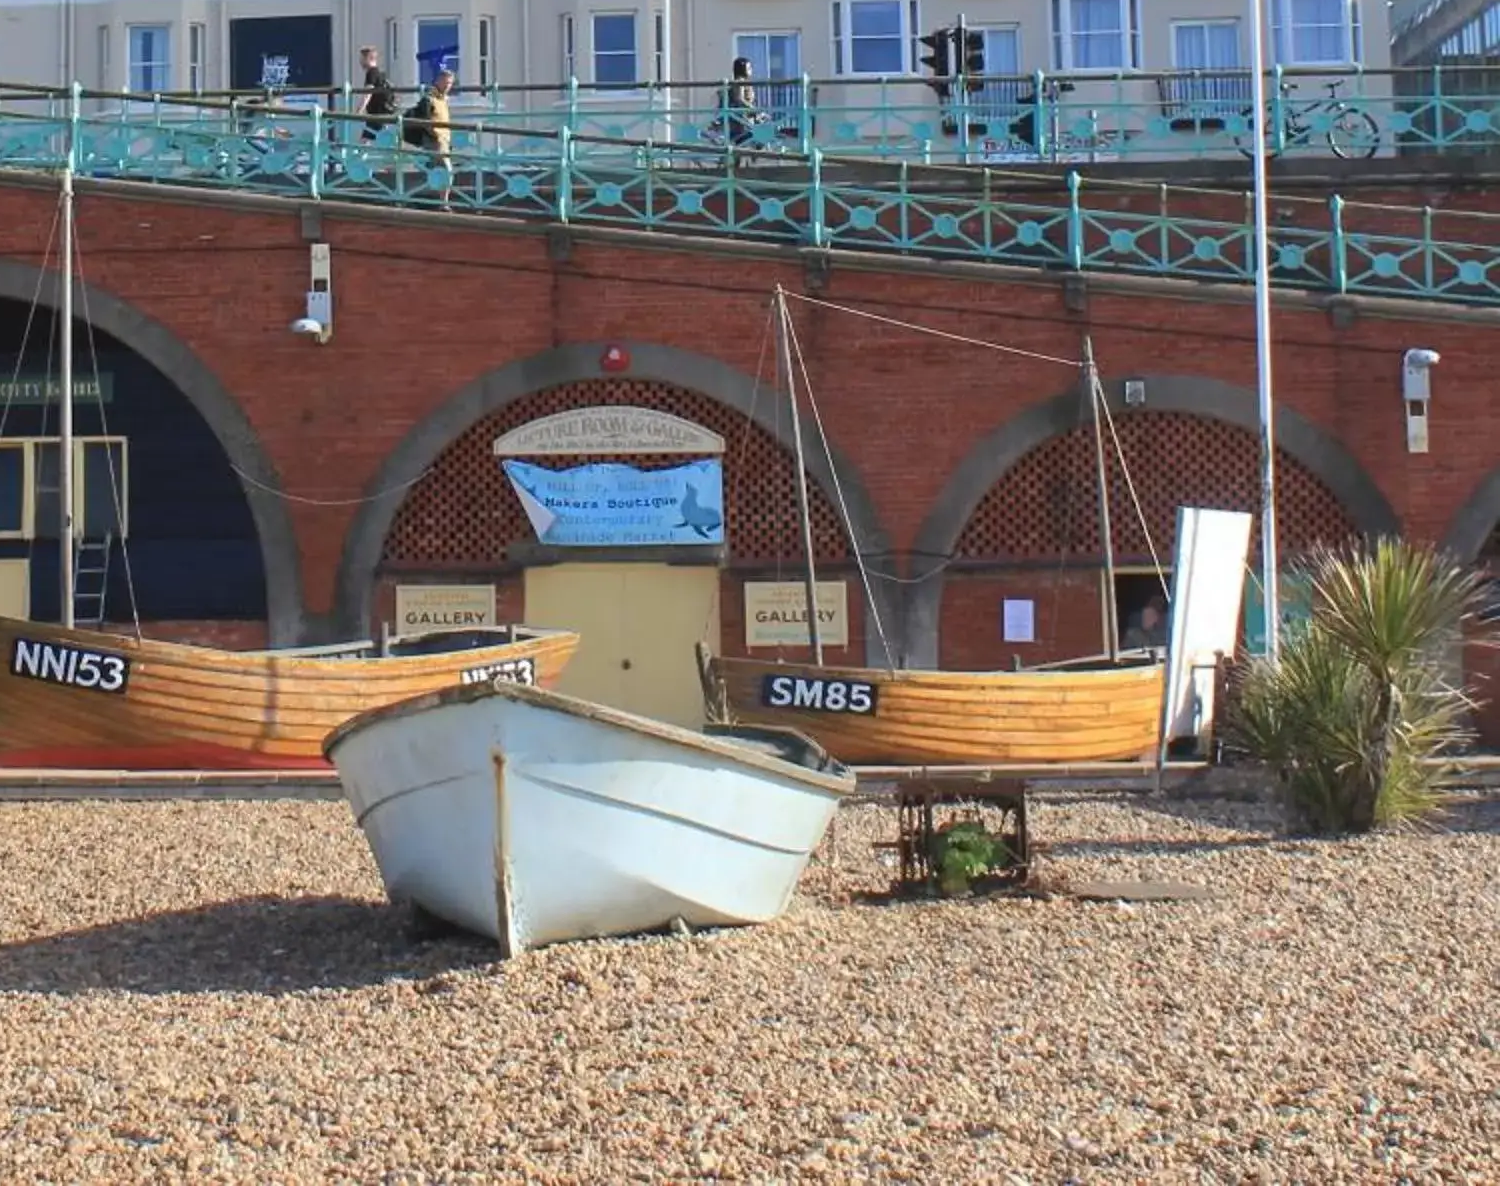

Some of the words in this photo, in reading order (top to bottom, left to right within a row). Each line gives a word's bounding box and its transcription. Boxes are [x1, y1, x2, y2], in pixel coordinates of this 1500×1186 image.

[544, 497, 598, 509] Makers
[607, 496, 678, 509] Boutique
[405, 611, 485, 625] GALLERY
[770, 677, 871, 712] SM85
